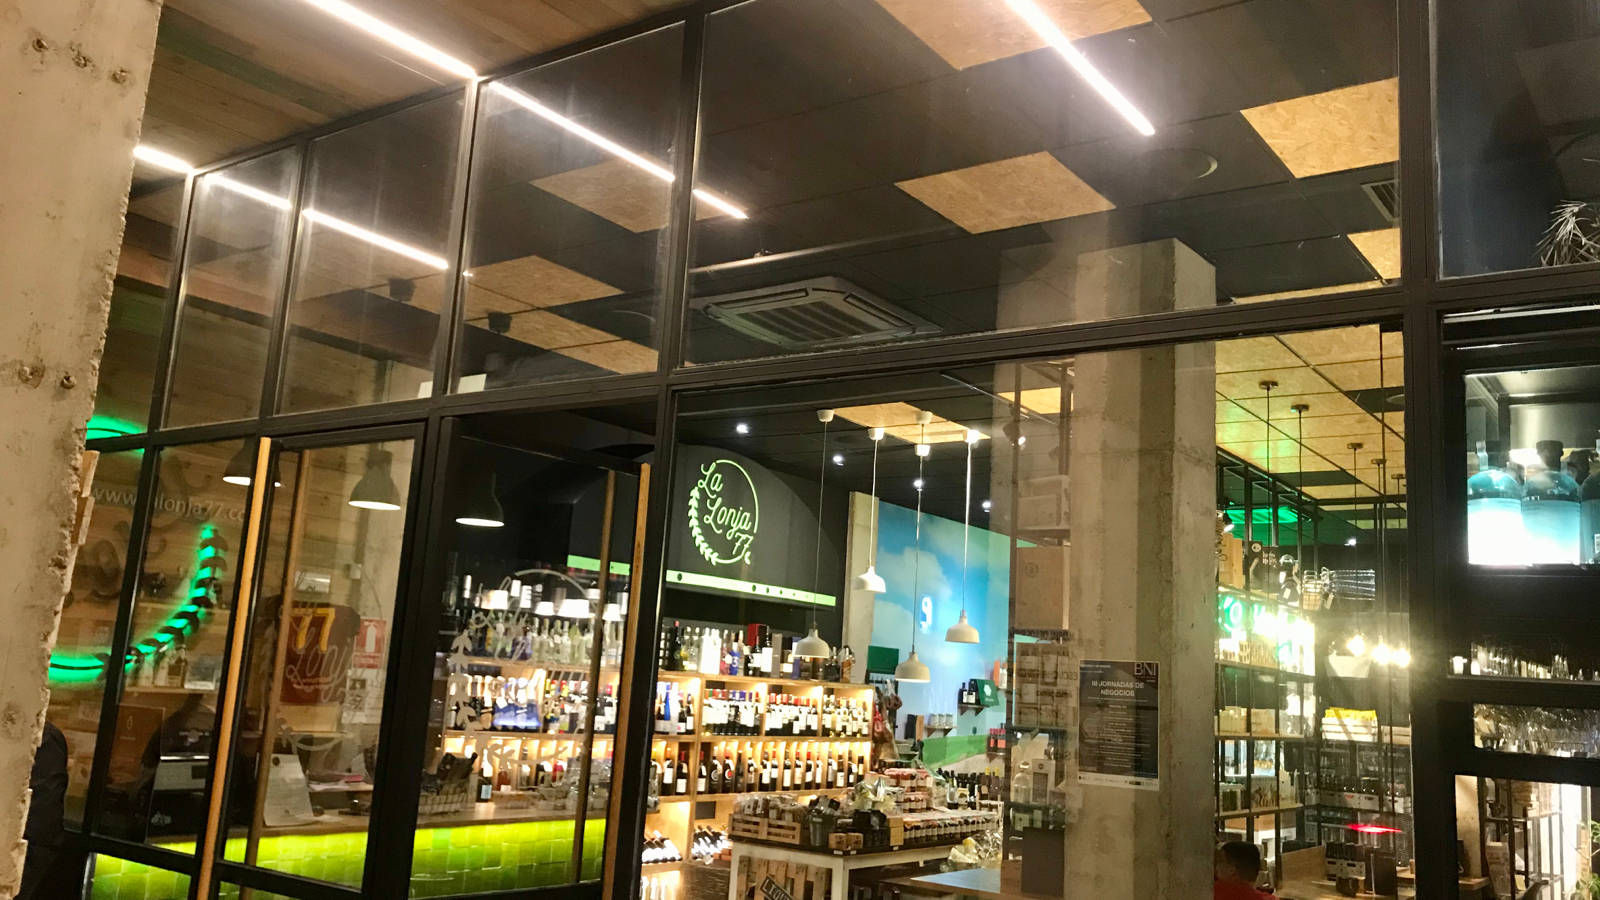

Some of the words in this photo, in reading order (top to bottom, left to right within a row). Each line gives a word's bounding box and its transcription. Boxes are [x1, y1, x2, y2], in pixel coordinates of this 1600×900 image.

[698, 462, 723, 498] La
[703, 497, 752, 540] Lonja
[734, 532, 754, 555] 77
[291, 608, 335, 651] 77
[1134, 662, 1156, 676] BNI
[1100, 689, 1135, 697] NEGOCIOS
